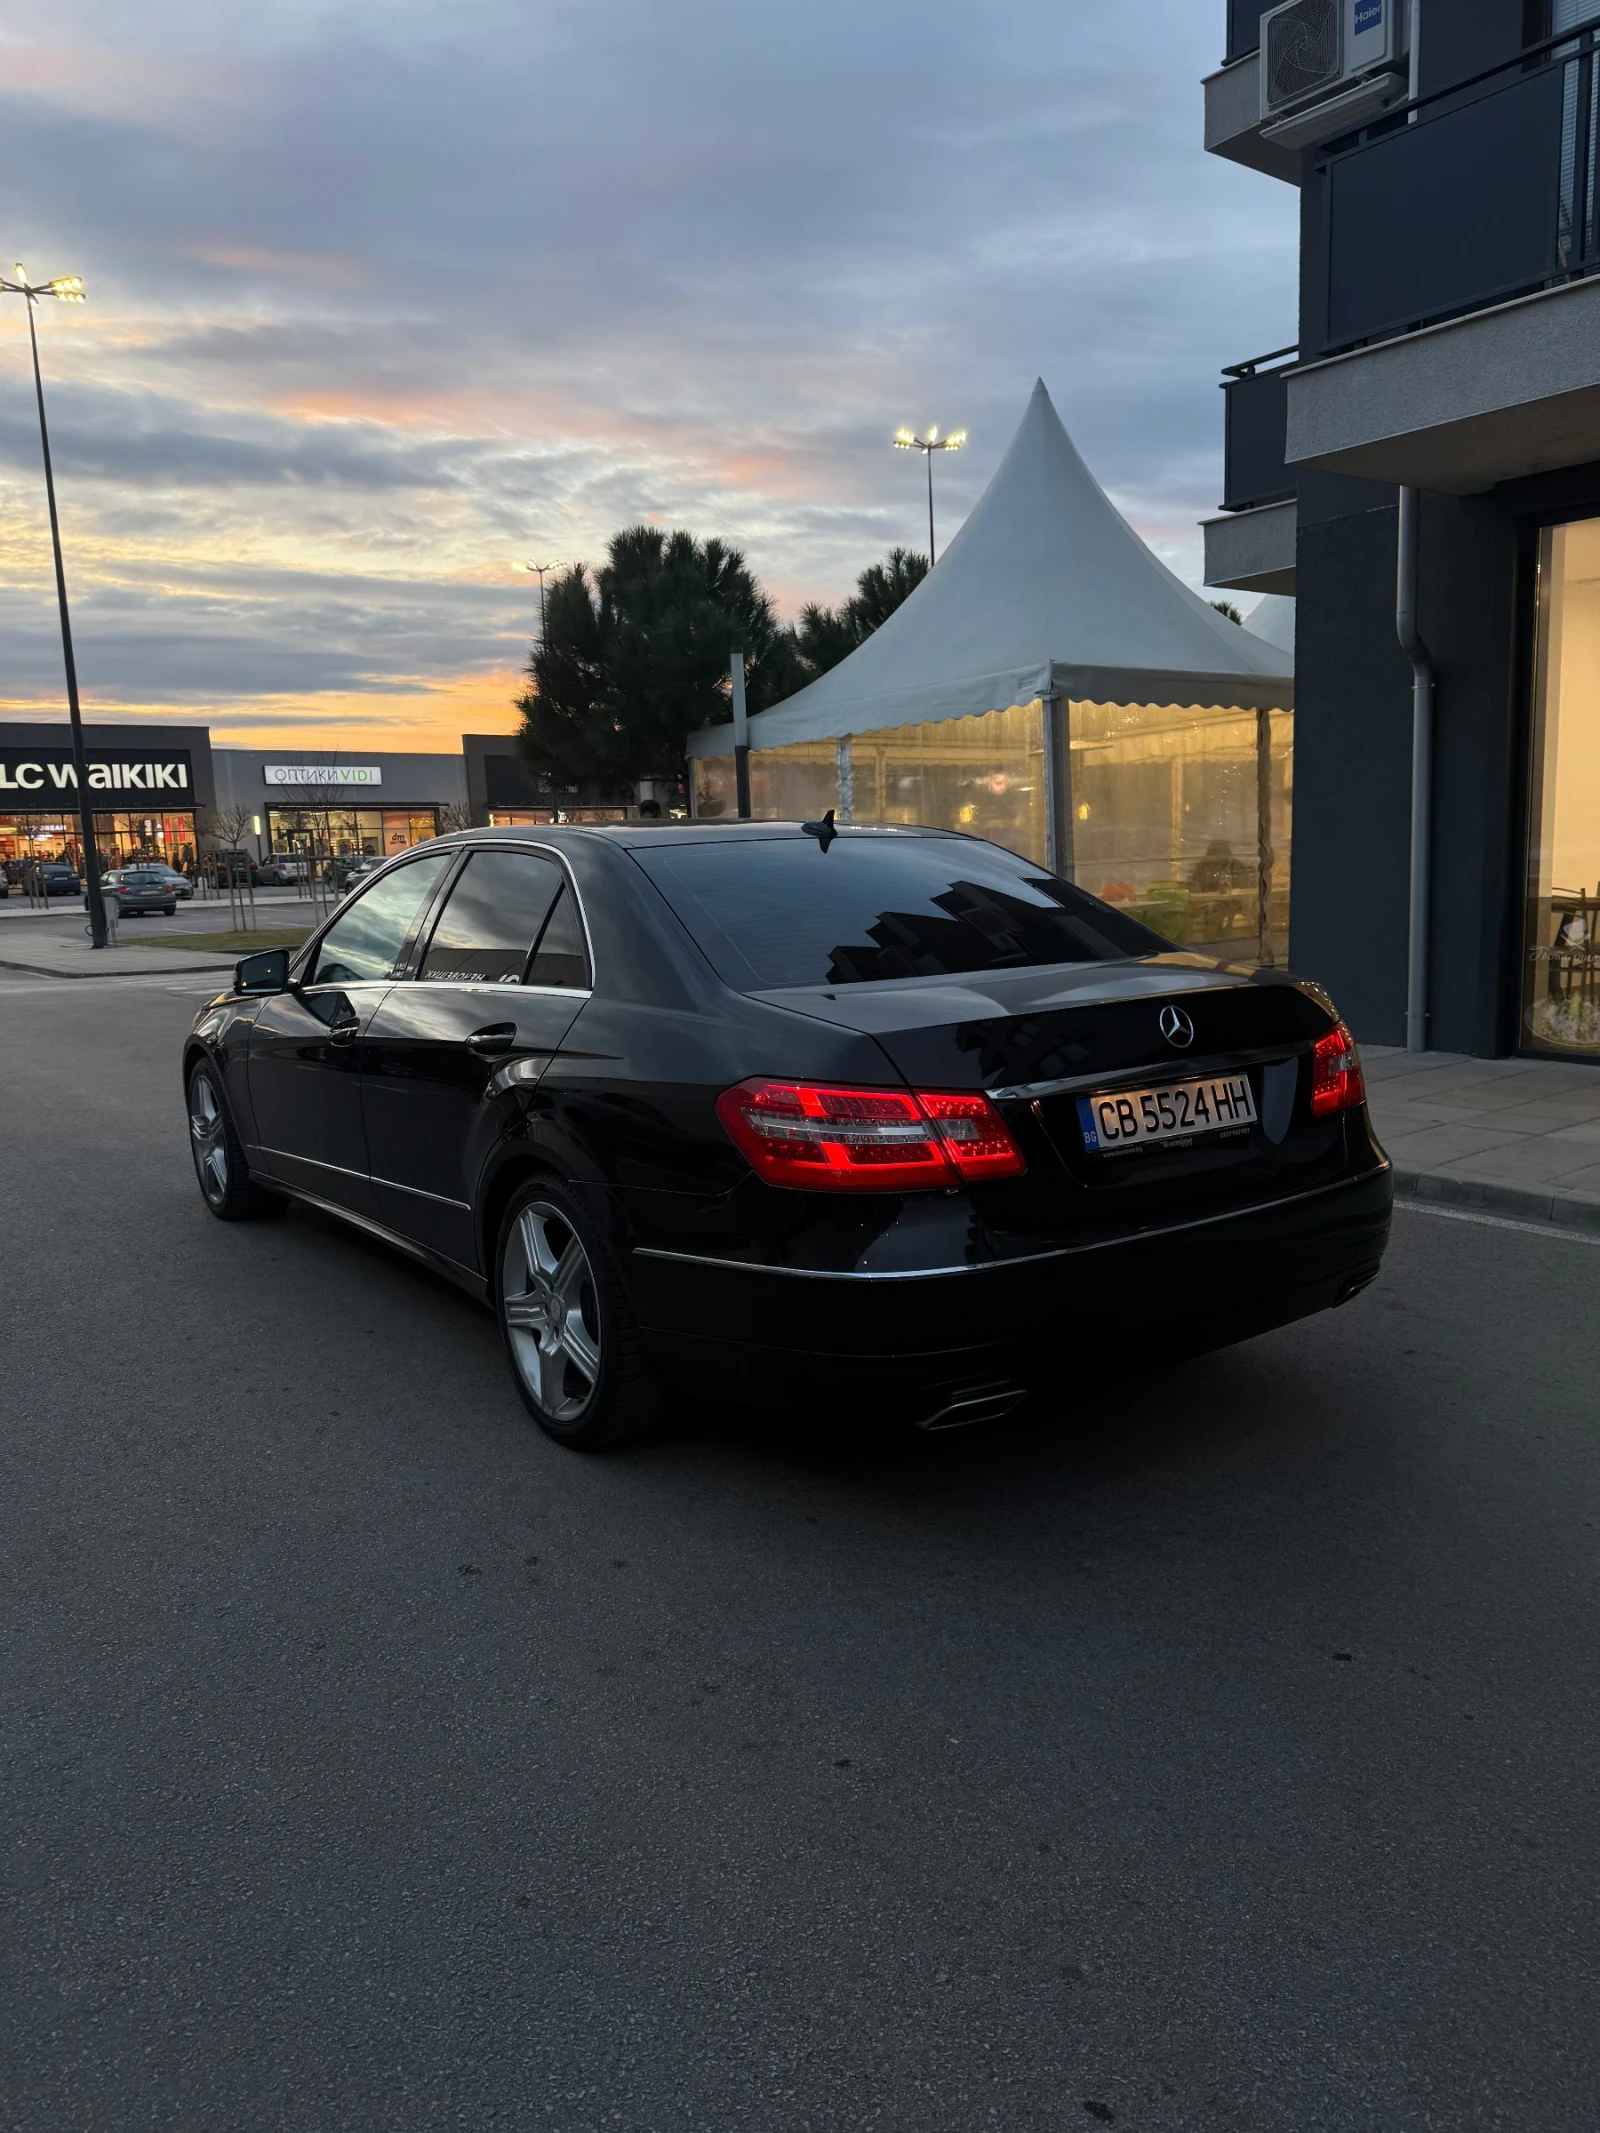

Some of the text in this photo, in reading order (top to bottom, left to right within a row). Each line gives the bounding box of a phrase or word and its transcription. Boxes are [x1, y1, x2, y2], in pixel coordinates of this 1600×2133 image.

[1355, 4, 1381, 24] Haier
[0, 763, 44, 789] LC
[275, 768, 373, 782] ОПТИКИ VIDI
[391, 832, 405, 841] dm
[1099, 1080, 1251, 1140] CB 5524 HH
[1084, 1131, 1097, 1144] BG
